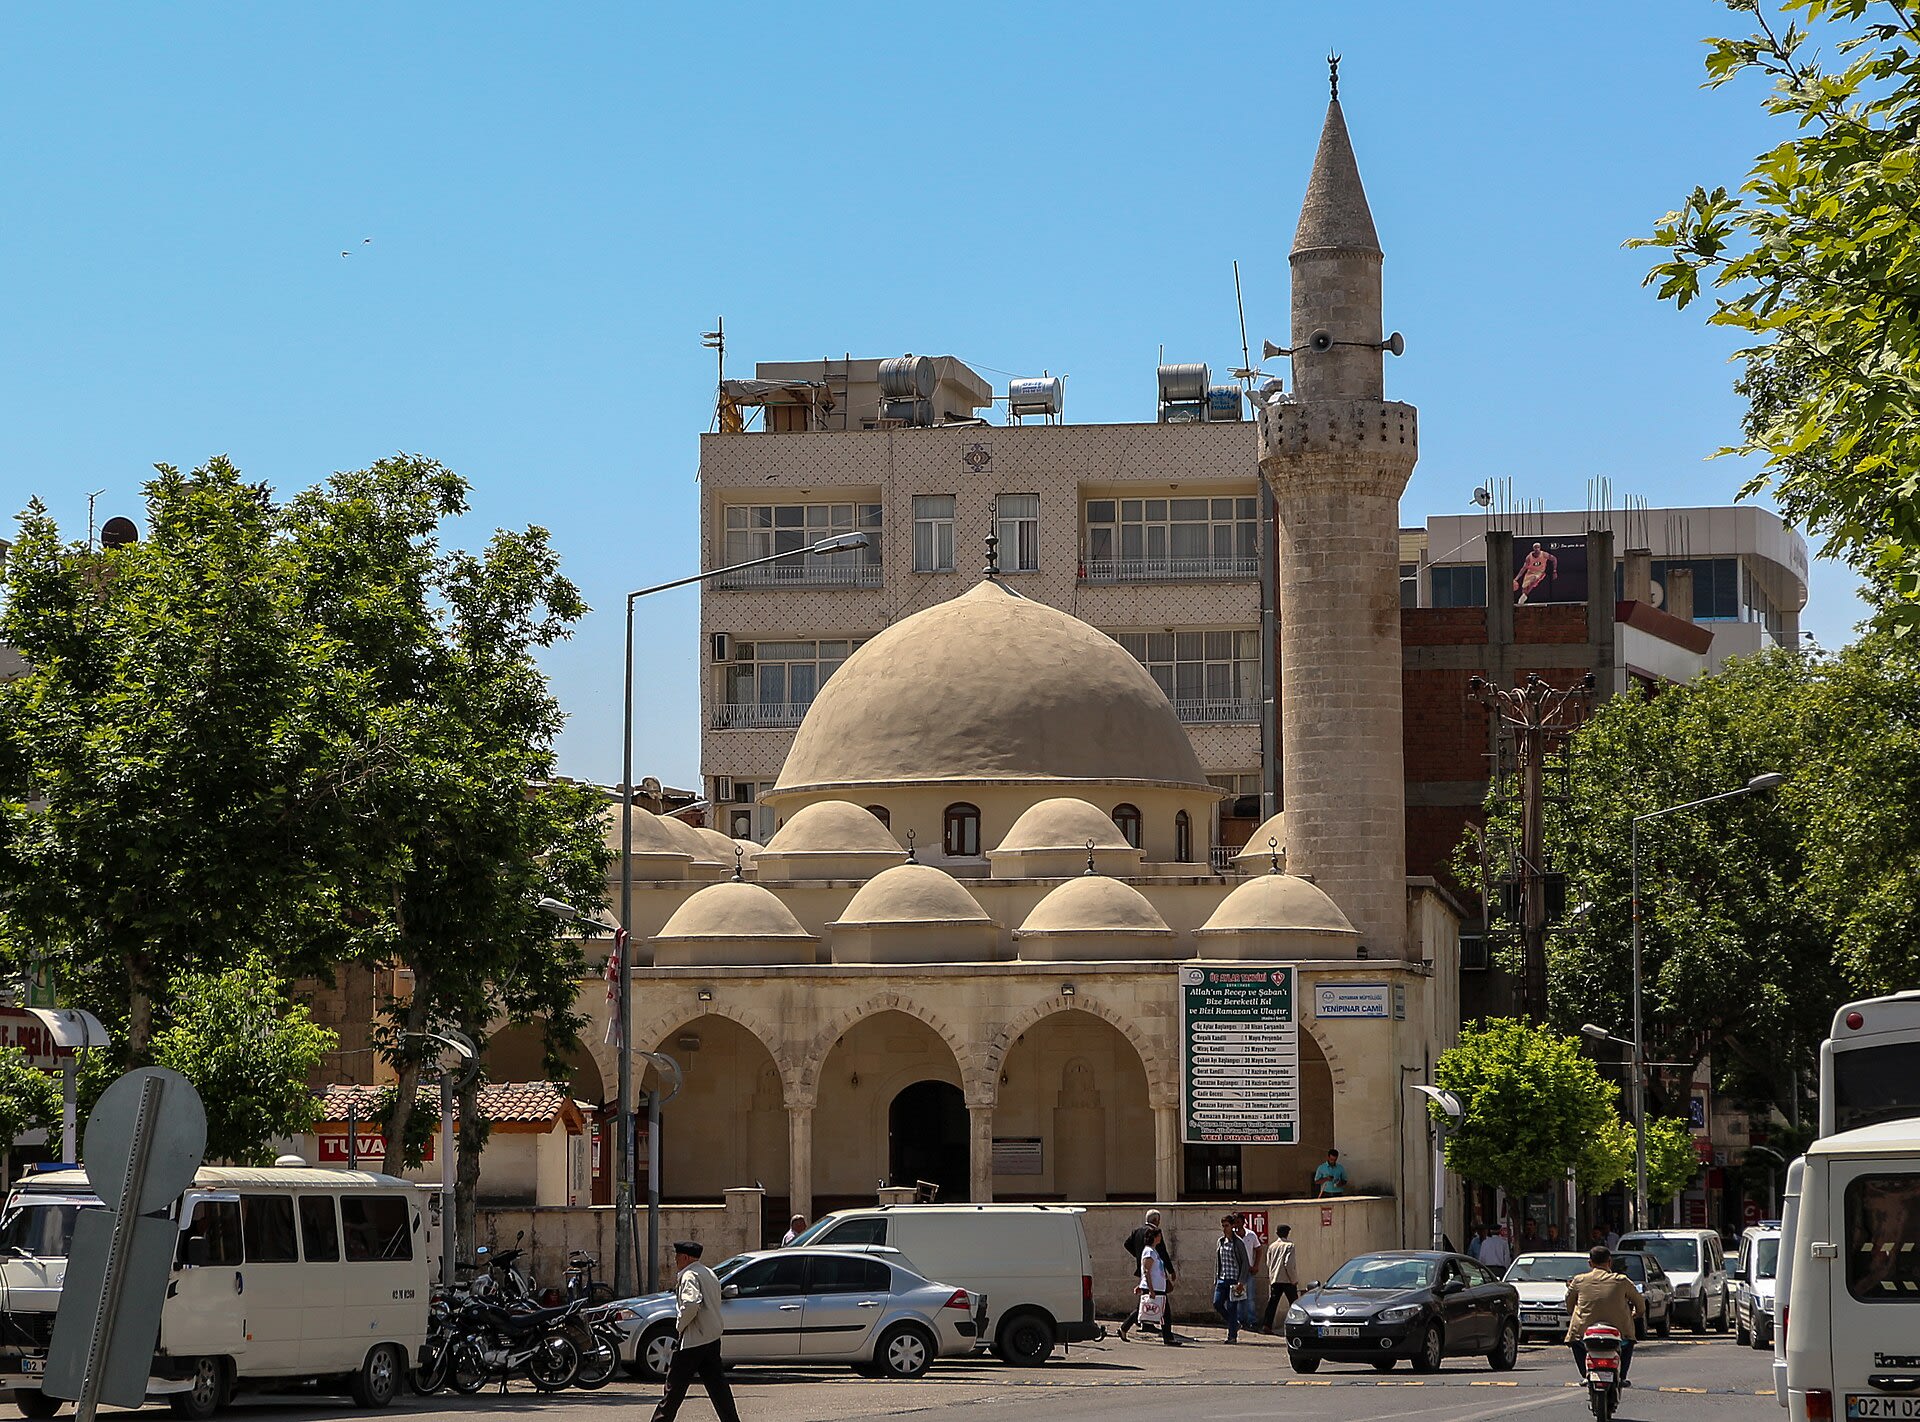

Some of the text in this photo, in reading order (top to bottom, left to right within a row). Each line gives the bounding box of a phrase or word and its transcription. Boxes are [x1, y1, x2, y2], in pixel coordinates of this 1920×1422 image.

[1224, 989, 1246, 997] Recep
[1258, 989, 1287, 997] Şaban'ı
[27, 1361, 37, 1370] 02
[1859, 1399, 1879, 1416] 02
[1884, 1400, 1895, 1416] M
